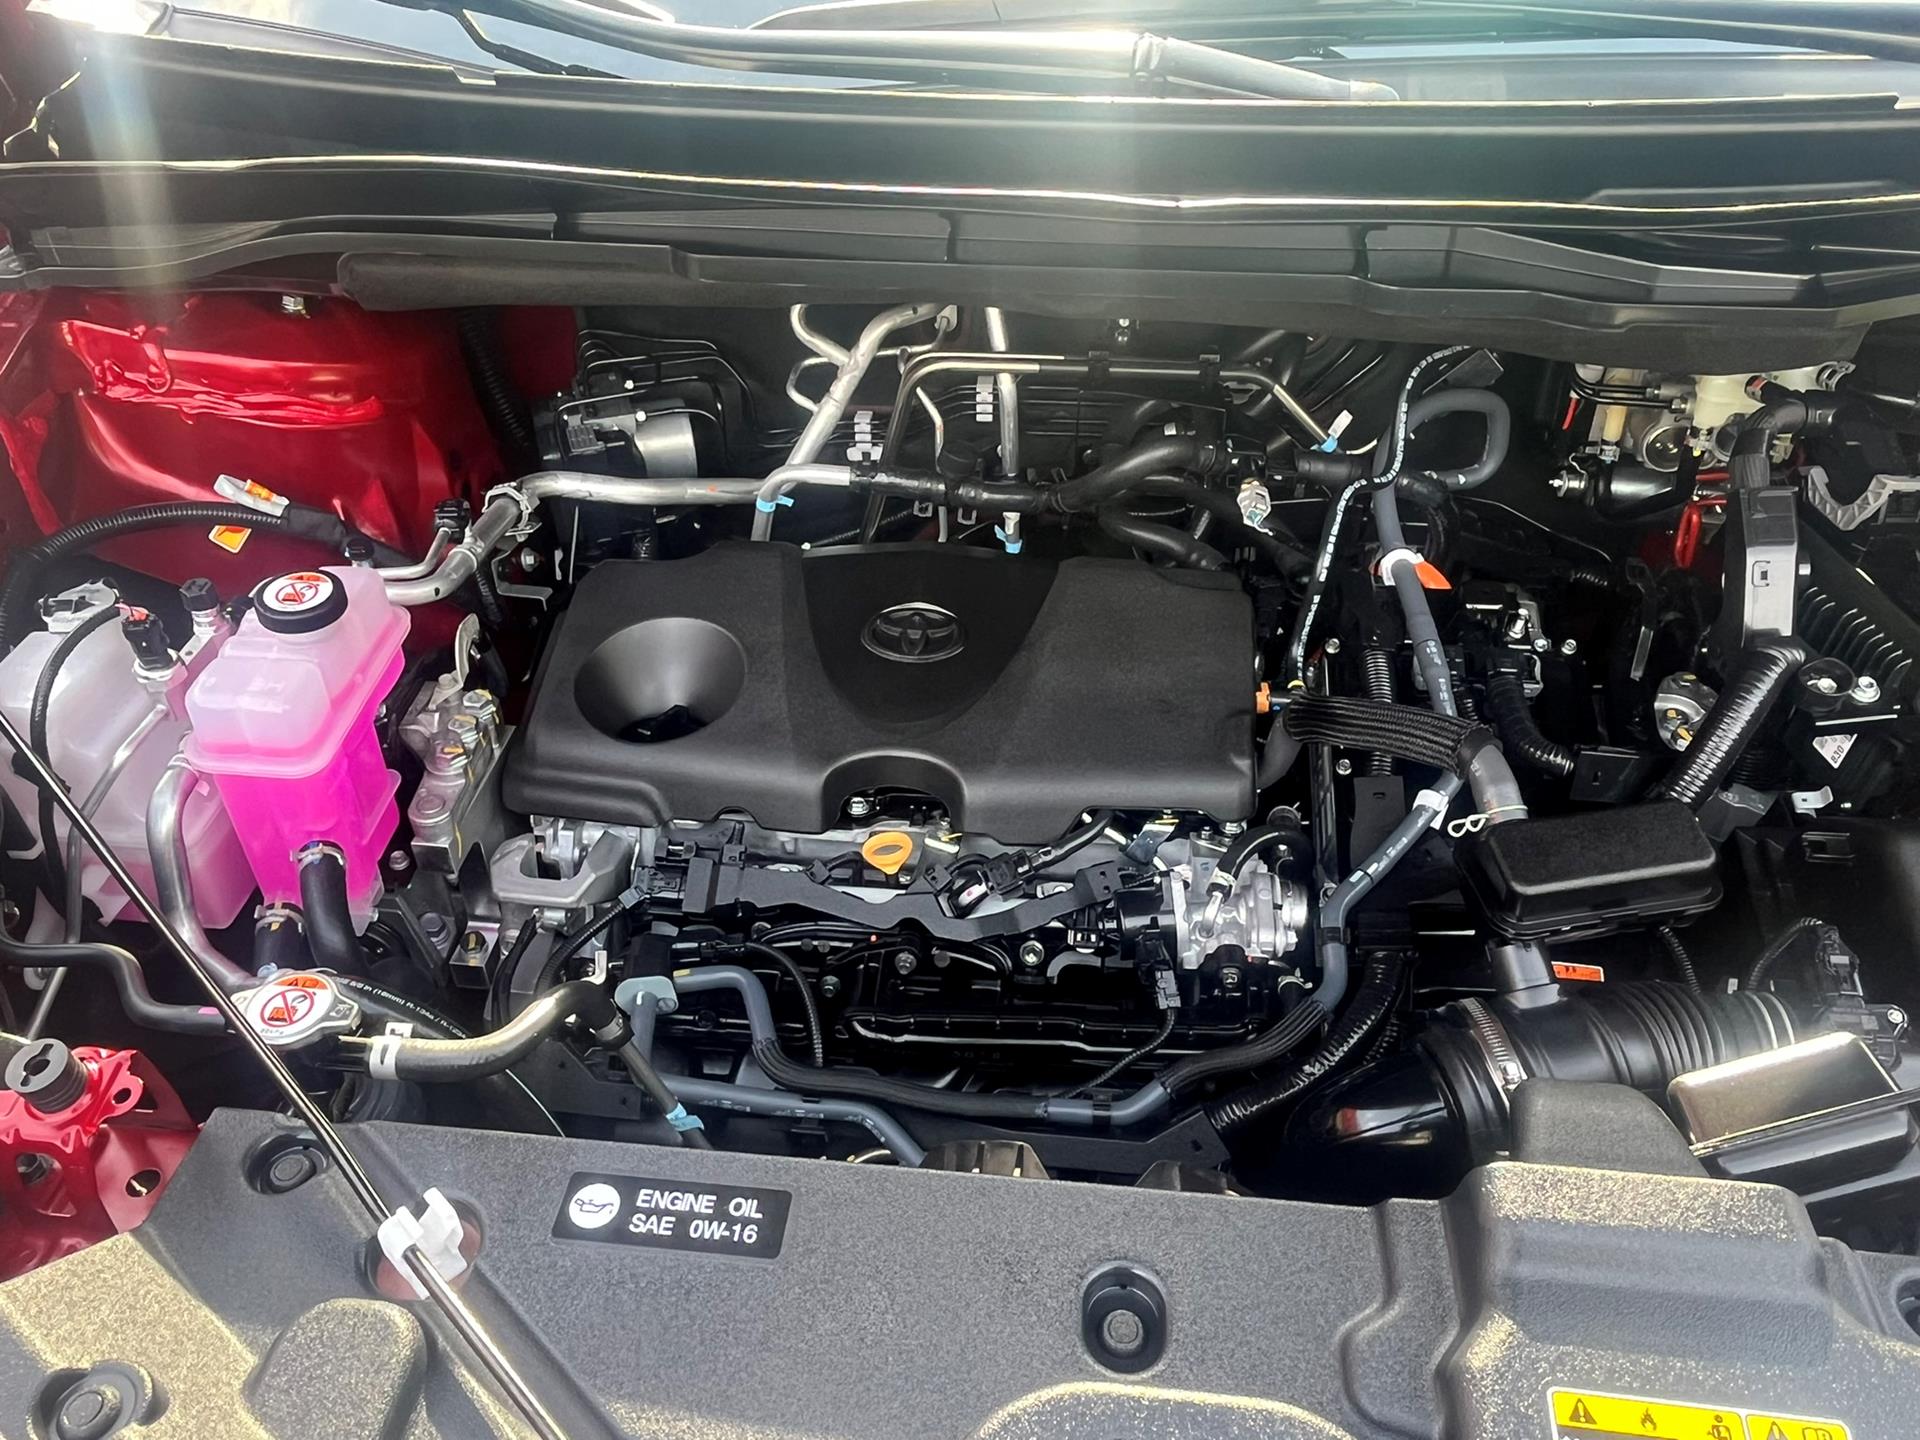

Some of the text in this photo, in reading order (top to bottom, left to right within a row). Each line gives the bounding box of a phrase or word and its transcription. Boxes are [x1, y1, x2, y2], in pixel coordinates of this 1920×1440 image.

[635, 1188, 764, 1219] ENGINE OIL
[628, 1213, 759, 1244] SAE 0W-16
